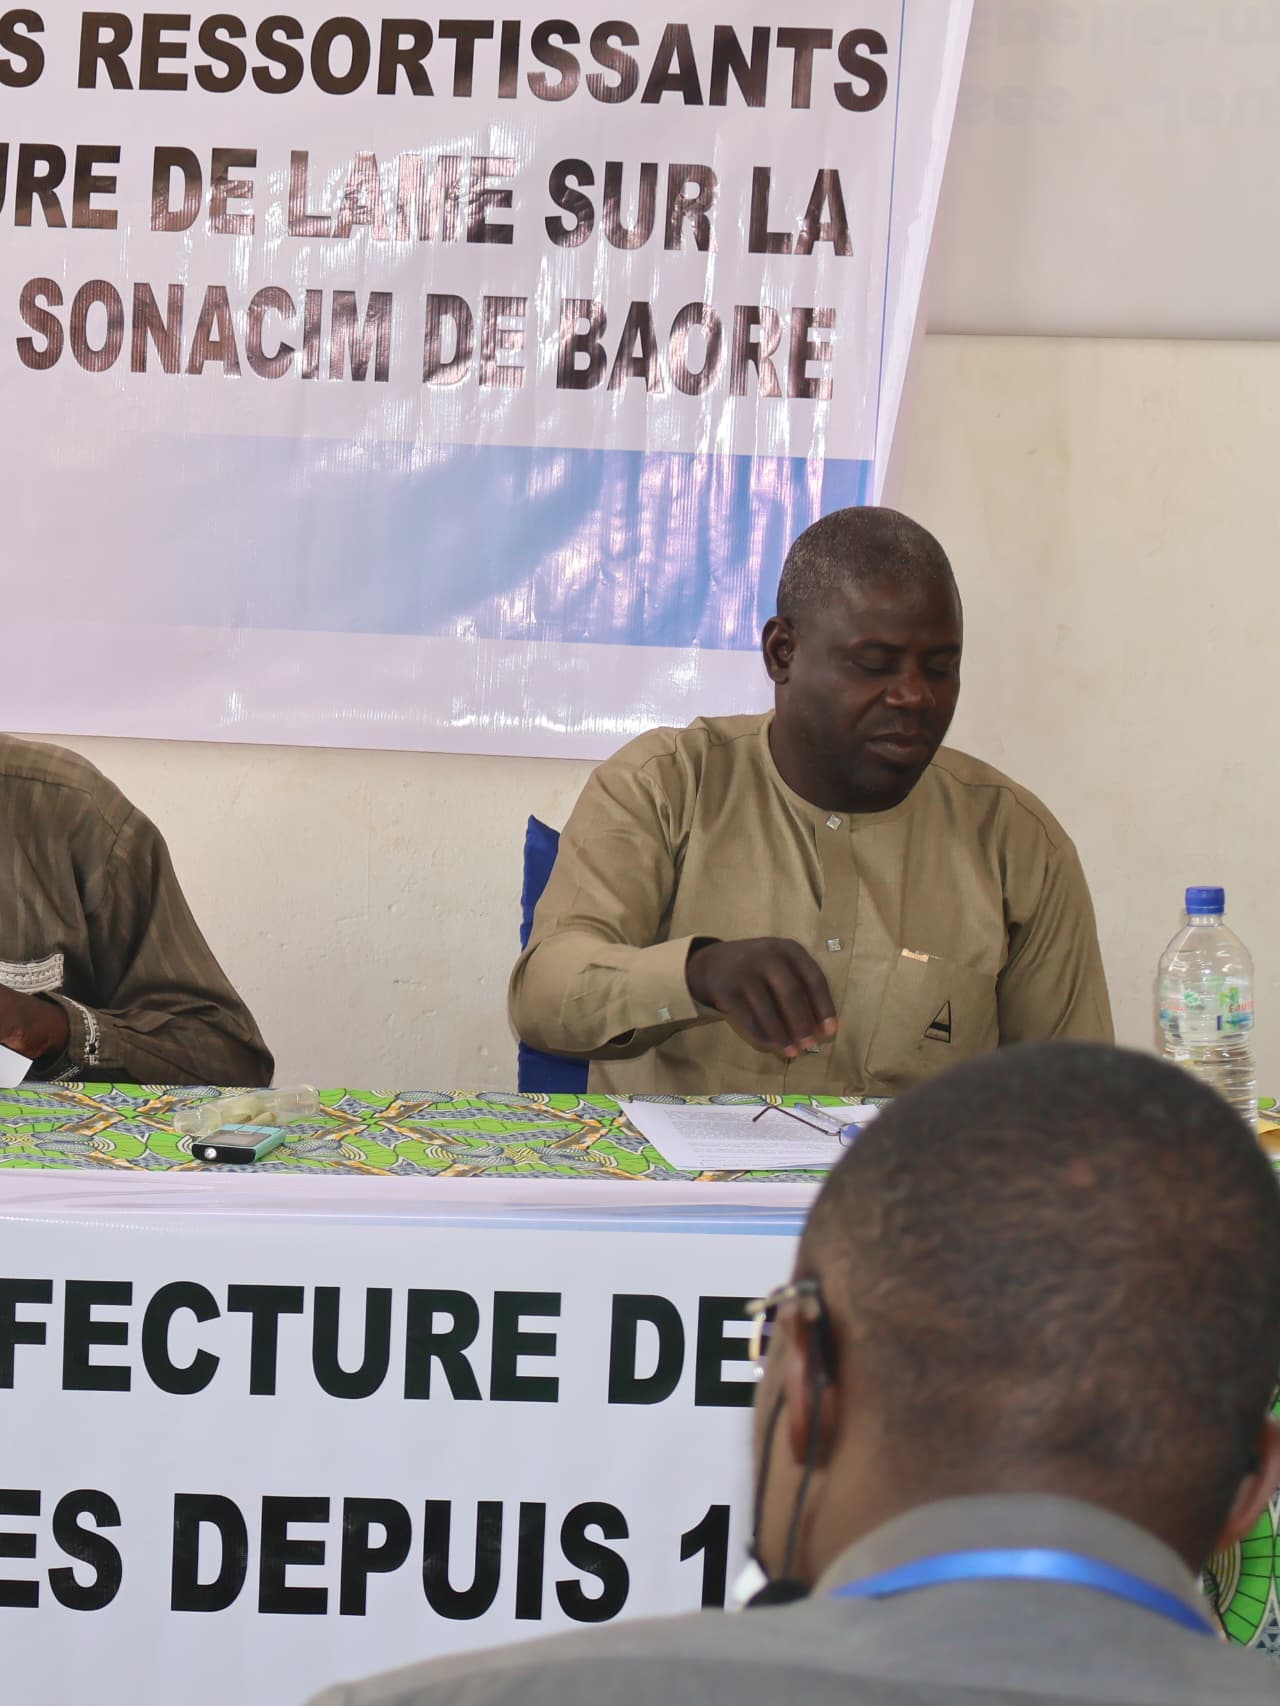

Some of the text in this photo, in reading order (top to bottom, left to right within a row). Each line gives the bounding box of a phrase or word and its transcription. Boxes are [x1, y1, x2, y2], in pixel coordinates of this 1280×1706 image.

[77, 12, 888, 112] RESSORTISSANTS
[151, 146, 257, 236] DE
[288, 150, 516, 244] LAME
[545, 159, 718, 253] SUR
[748, 166, 853, 257] LA
[16, 278, 392, 382] SONACIM
[422, 293, 528, 388] DE
[556, 298, 837, 400] BAORE
[608, 1294, 770, 1407] DE
[171, 1494, 629, 1622] DEPUIS
